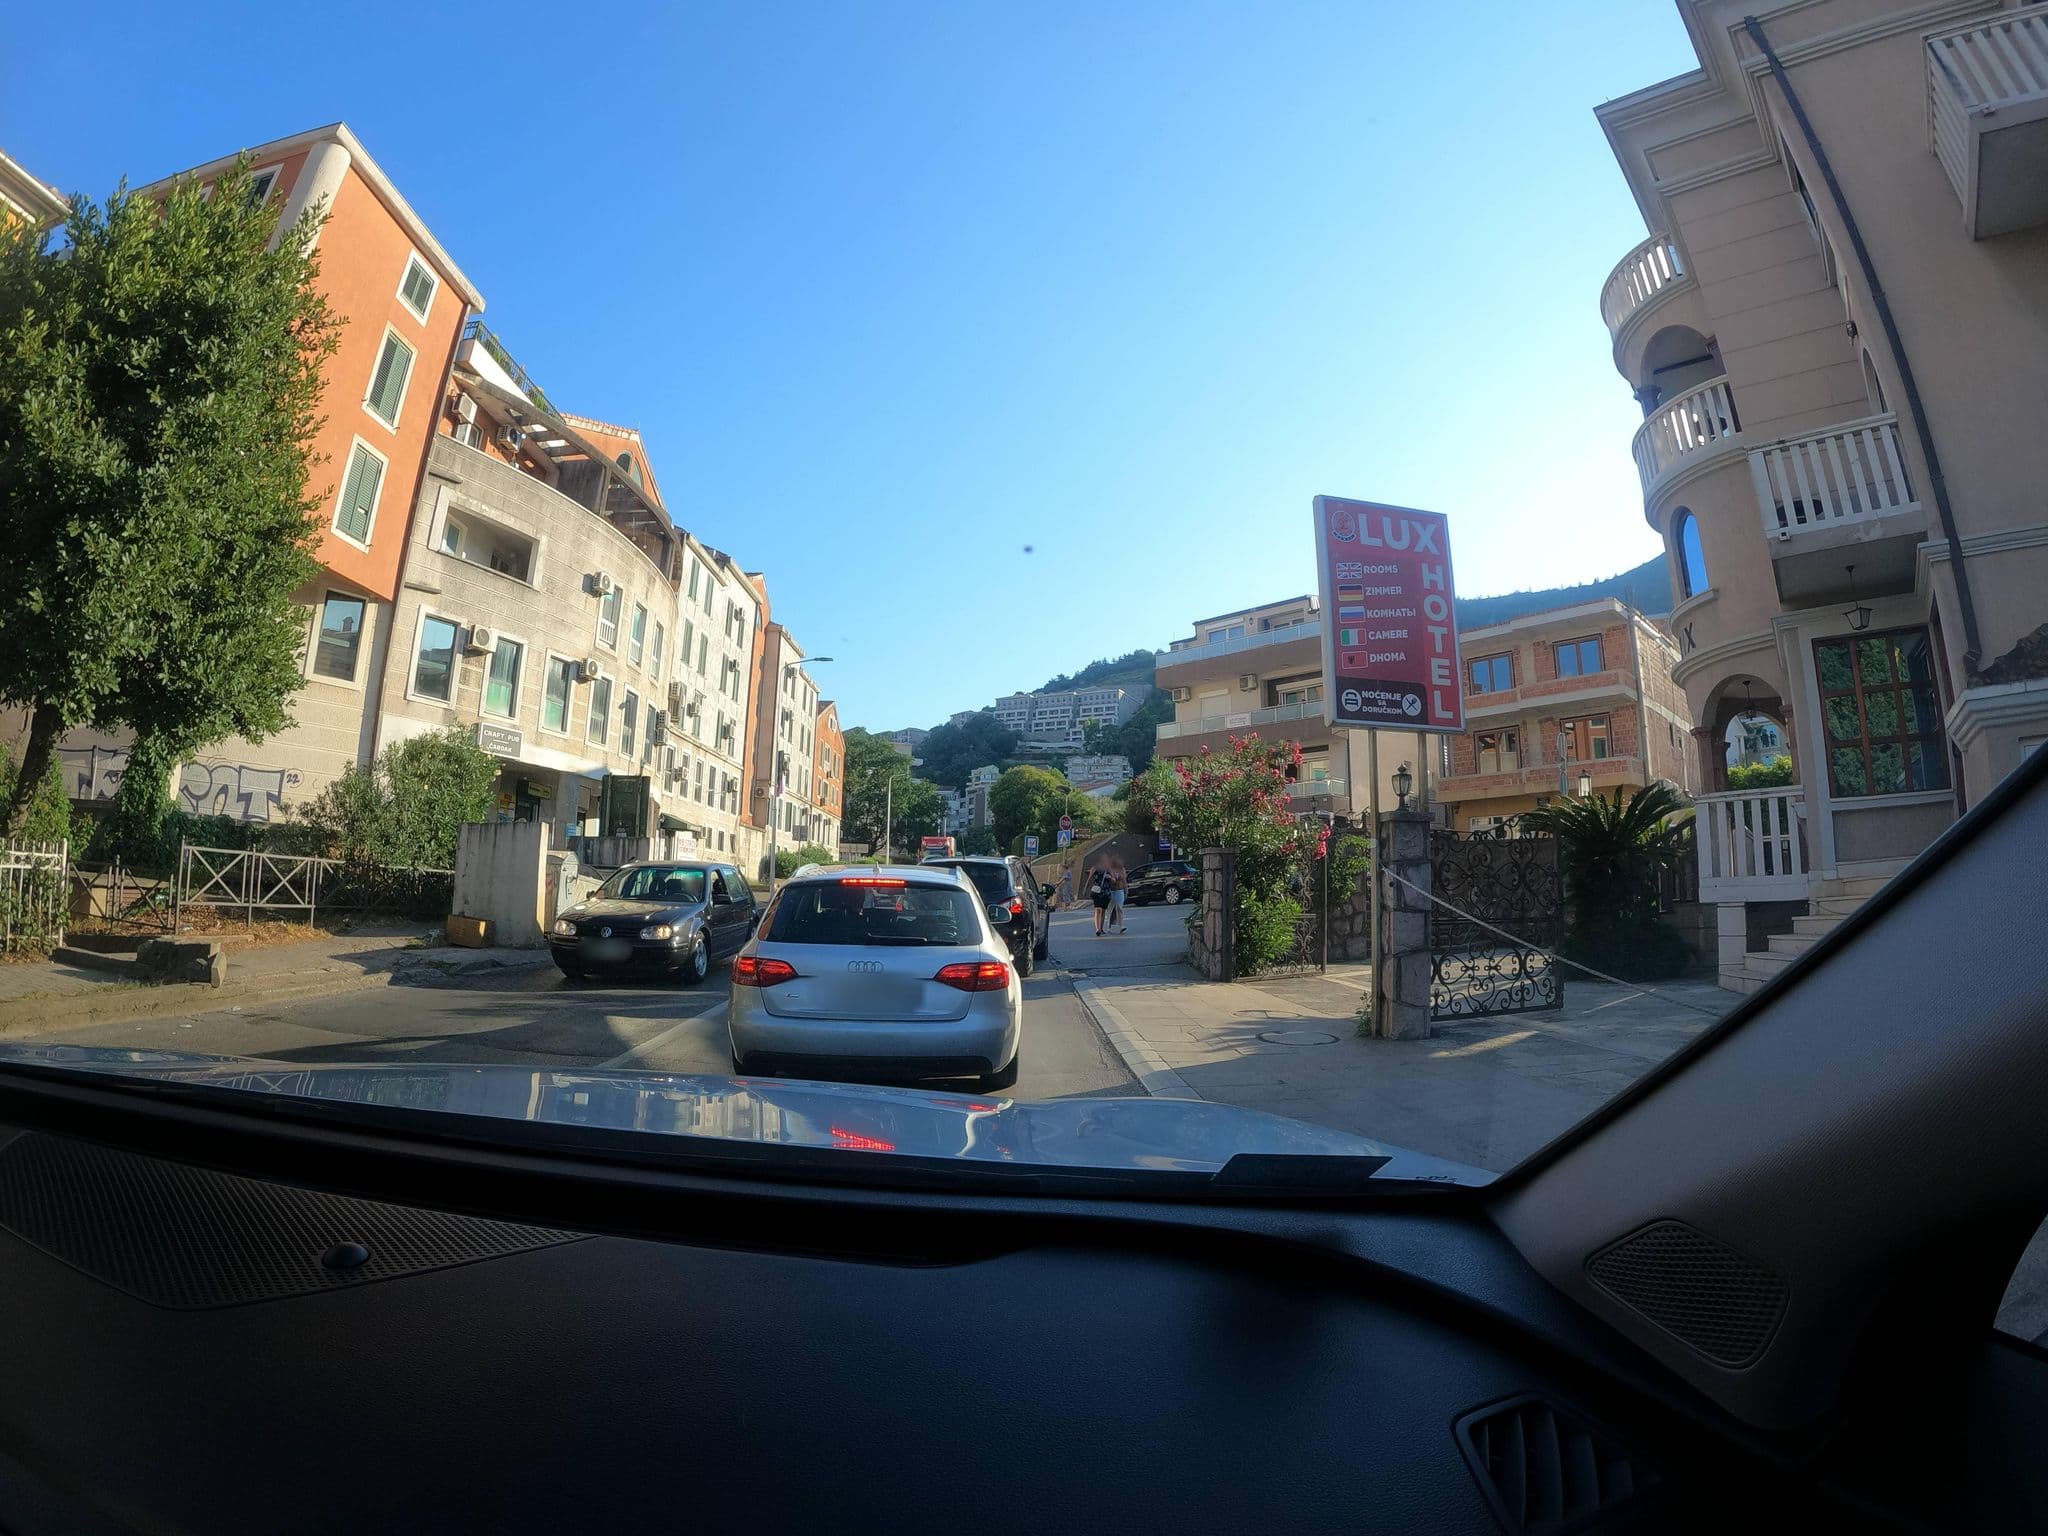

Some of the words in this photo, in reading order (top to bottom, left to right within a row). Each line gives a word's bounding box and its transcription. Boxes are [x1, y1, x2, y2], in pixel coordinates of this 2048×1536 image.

[1358, 513, 1440, 555] LUX
[1363, 565, 1399, 574] ROOMS
[1365, 586, 1402, 596] ZIMMER
[1366, 608, 1416, 619] КОМНАТЫ
[1368, 629, 1409, 640] CAMERE
[1421, 562, 1453, 719] HOTEL
[1369, 652, 1407, 663] DHOMA
[483, 729, 505, 739] CRAFT
[507, 734, 520, 743] PUB
[286, 773, 300, 784] 22
